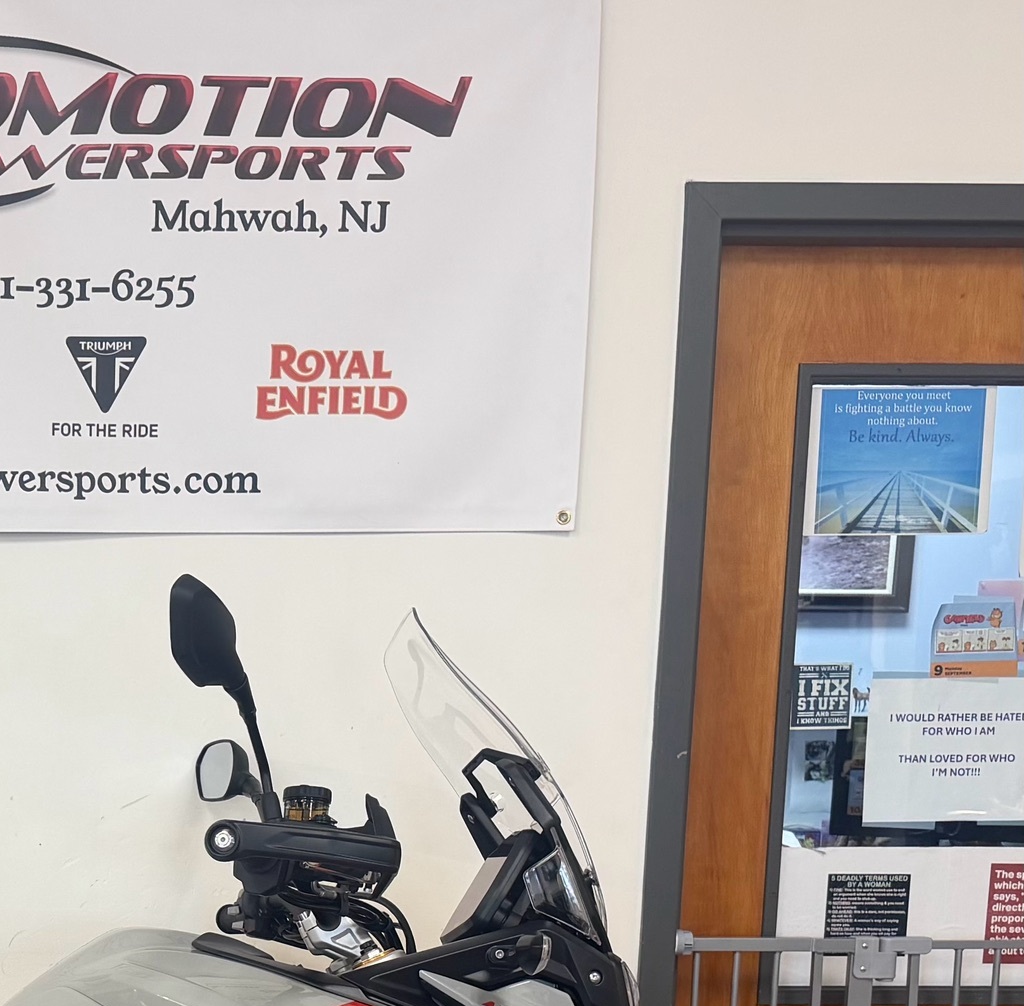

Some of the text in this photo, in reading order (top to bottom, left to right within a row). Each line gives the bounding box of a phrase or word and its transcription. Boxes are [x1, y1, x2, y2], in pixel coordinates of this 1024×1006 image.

[151, 198, 391, 239] Mahwah, NJ
[79, 341, 132, 355] TRIUMPH
[269, 343, 393, 382] ROYAL
[857, 390, 952, 402] Everyone you meet
[255, 386, 408, 420] ENFIELD
[834, 403, 972, 415] is fighting a battle you know
[867, 416, 938, 428] nothing about.
[51, 422, 159, 438] FOR THE RIDE
[849, 428, 954, 447] Be kind. Always.
[934, 665, 943, 676] 9
[798, 679, 849, 697] I FIX
[797, 697, 849, 711] STUFF
[895, 713, 935, 722] WOULD
[937, 713, 978, 722] RATHER
[980, 713, 993, 722] BE
[922, 727, 943, 735] FOR
[945, 727, 972, 735] WHO
[979, 727, 995, 735] AM
[899, 754, 1016, 763] THAN LOVED FOR WHO
[932, 768, 981, 776] I'M NOT!!!
[995, 870, 1014, 878] The
[994, 881, 1024, 889] which
[993, 893, 1019, 902] says,
[990, 924, 1007, 933] the
